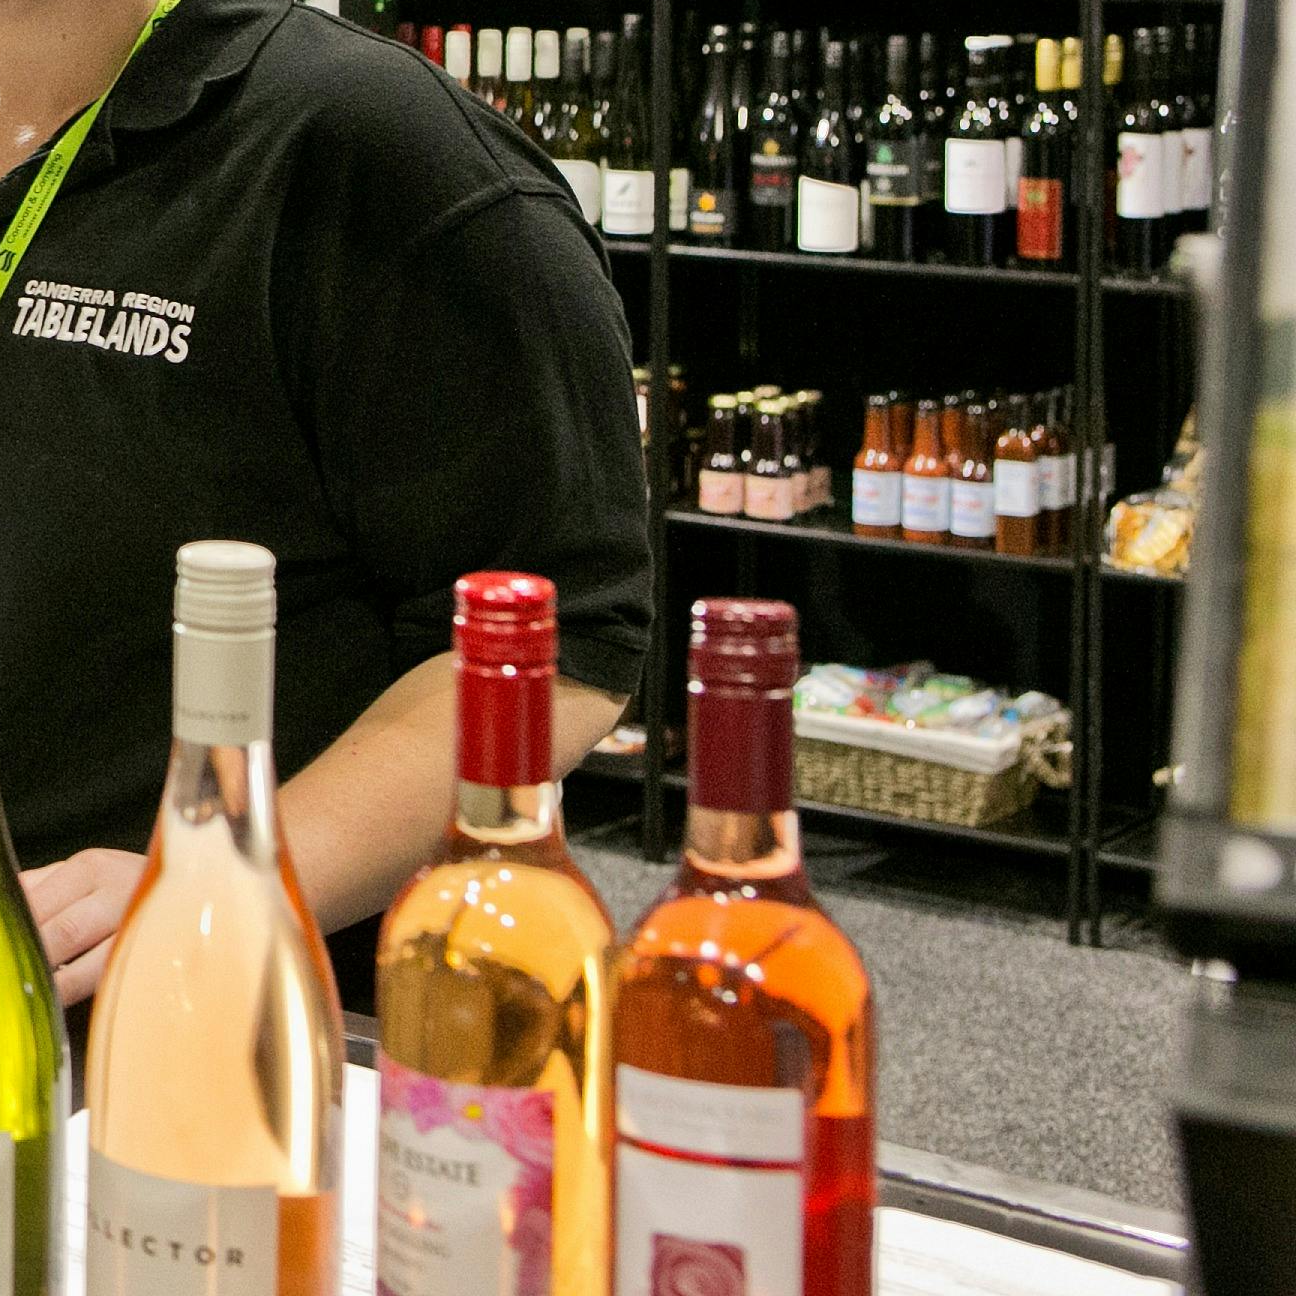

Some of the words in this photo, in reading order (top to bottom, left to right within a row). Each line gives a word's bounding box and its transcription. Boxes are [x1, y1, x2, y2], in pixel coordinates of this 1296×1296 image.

[6, 206, 33, 244] Caravan
[33, 153, 63, 194] Camping
[12, 297, 192, 364] TABLELANDS
[24, 279, 115, 307] CANBERRA
[121, 291, 196, 324] REGION
